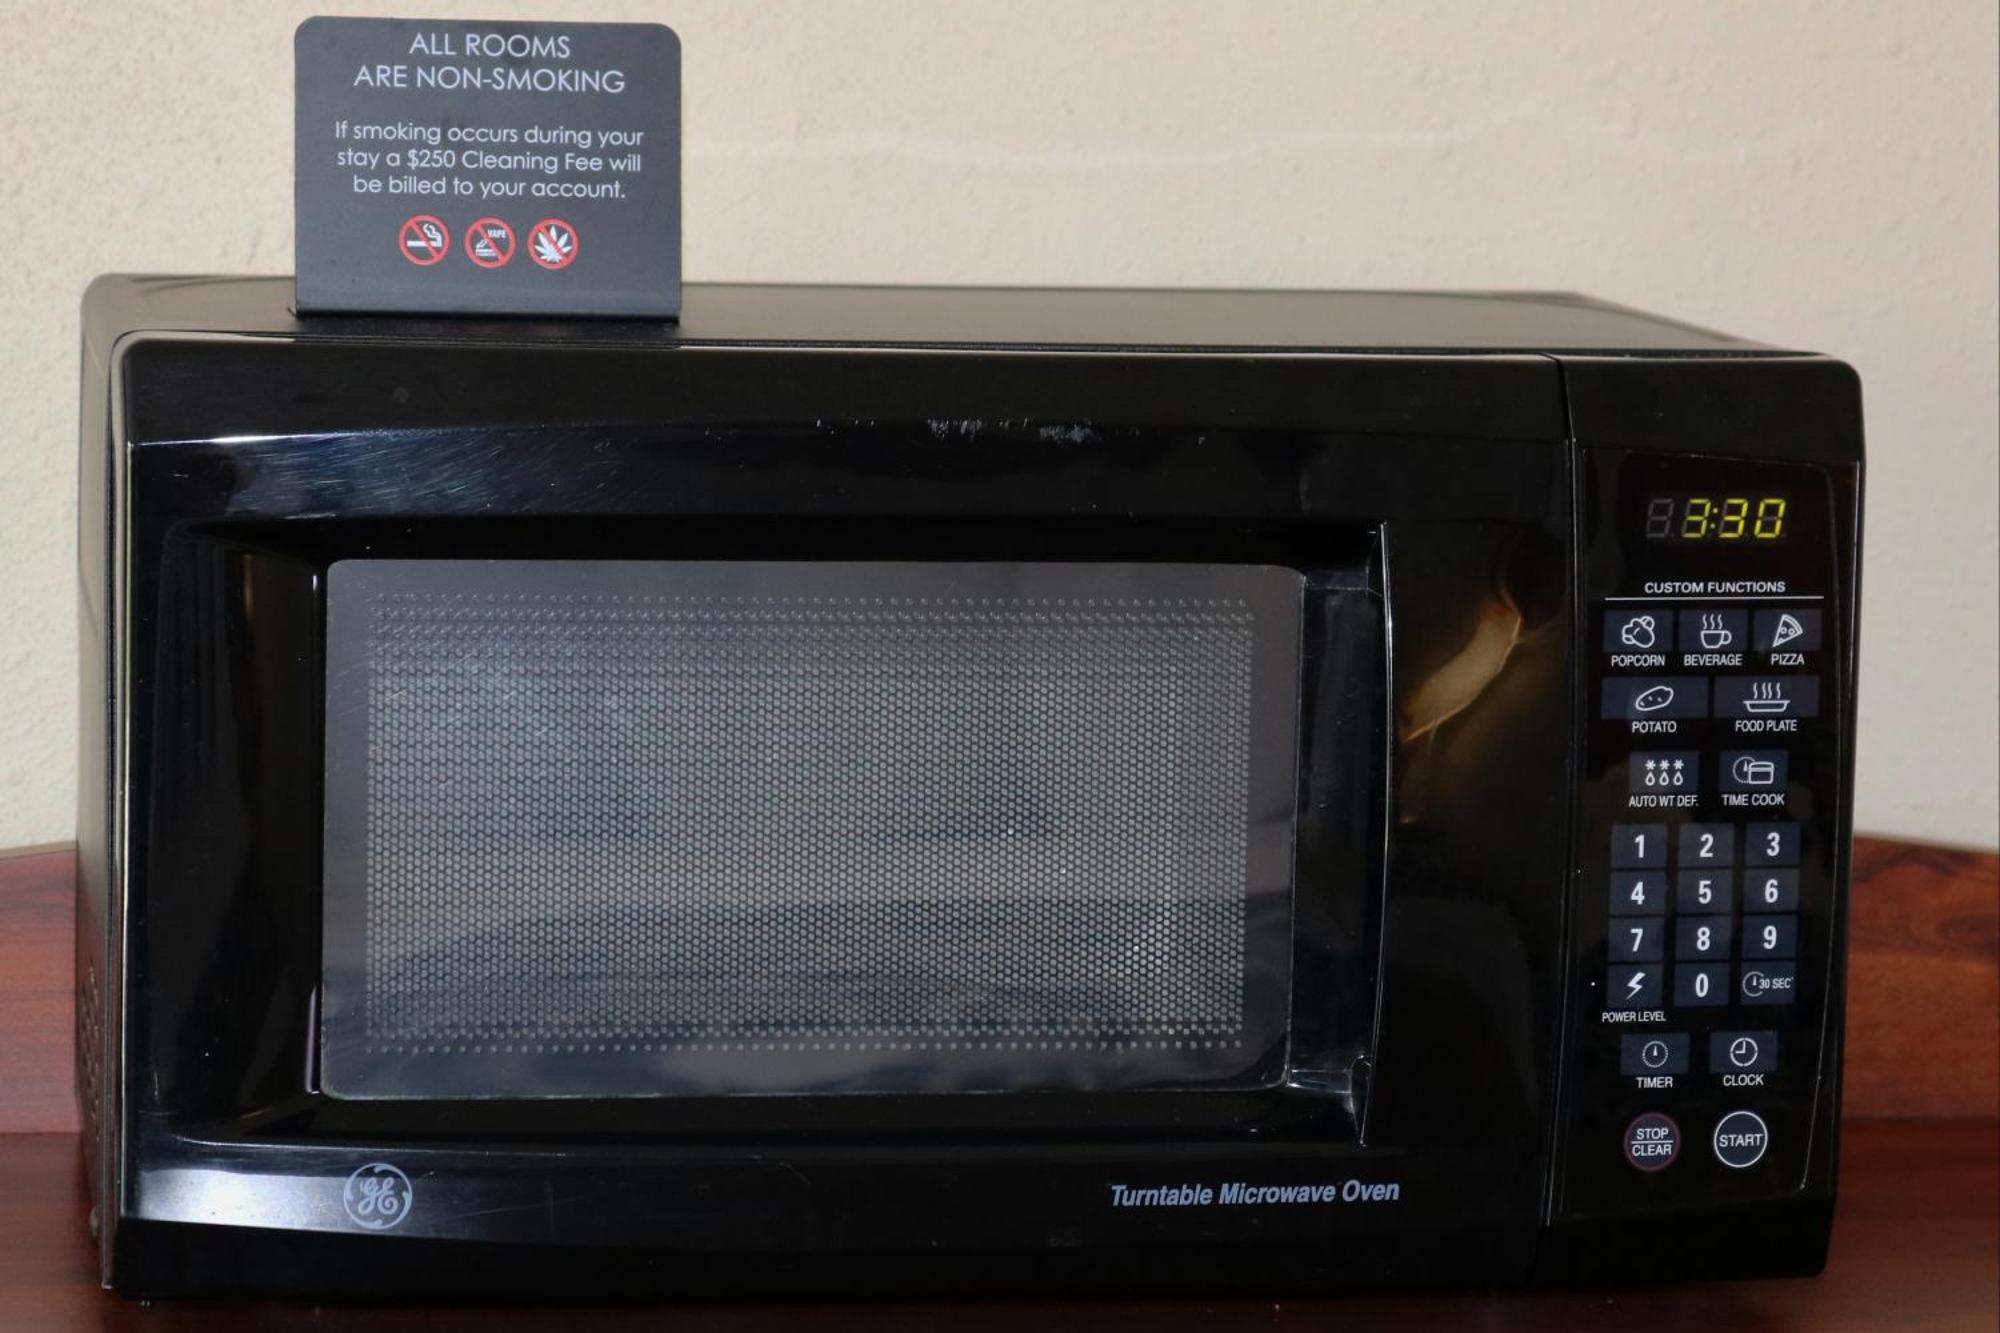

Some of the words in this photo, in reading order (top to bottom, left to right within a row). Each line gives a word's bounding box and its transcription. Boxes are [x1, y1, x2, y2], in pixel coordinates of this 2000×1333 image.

[409, 32, 456, 56] ALL
[466, 34, 571, 58] ROOMS
[353, 65, 407, 87] ARE
[416, 67, 626, 93] NON-SMOKING
[335, 121, 349, 140] If
[352, 122, 441, 145] smoking
[447, 125, 518, 143] occurs
[524, 125, 592, 148] during
[598, 129, 644, 147] your
[337, 150, 380, 171] stay
[386, 152, 401, 167] a
[406, 148, 456, 169] $250
[461, 150, 558, 174] Cleaning
[564, 153, 603, 171] Fee
[608, 154, 641, 172] will
[353, 175, 383, 193] be
[388, 175, 446, 195] billed
[453, 178, 473, 195] to
[480, 180, 526, 199] your
[531, 180, 626, 199] account.
[487, 229, 507, 239] VAPE
[1682, 498, 1786, 538] 3:30
[1644, 582, 1704, 594] CUSTOM
[1707, 581, 1786, 593] FUNCTIONS
[1611, 655, 1666, 667] POPCORN
[1683, 654, 1743, 666] BEVERAGE
[1771, 653, 1805, 665] PIZZA
[1631, 721, 1677, 733] POTATO
[1735, 720, 1765, 732] FOOD
[1766, 720, 1798, 732] PLATE
[1628, 795, 1657, 808] AUTO
[1658, 795, 1678, 807] WT
[1677, 795, 1699, 807] DEF.
[1721, 794, 1750, 806] TIME
[1751, 793, 1785, 806] COOK
[1634, 835, 1645, 859] 1
[1699, 833, 1714, 858] 2
[1766, 832, 1780, 857] 3
[1631, 881, 1645, 905] 4
[1698, 880, 1712, 904] 5
[1764, 879, 1779, 903] 6
[1630, 928, 1644, 952] 7
[1696, 926, 1711, 951] 8
[1763, 925, 1777, 950] 9
[1695, 973, 1709, 997] 0
[1759, 978, 1771, 990] 30
[1601, 1011, 1636, 1023] POWER
[1638, 1011, 1667, 1022] LEVEL
[1636, 1077, 1673, 1089] TIMER
[1723, 1074, 1764, 1087] CLOCK
[1636, 1128, 1669, 1140] STOP
[1719, 1134, 1764, 1147] START
[1631, 1144, 1672, 1157] CLEAR
[1111, 1184, 1213, 1207] Turntable
[1218, 1182, 1336, 1205] Microwave
[1342, 1180, 1400, 1202] Oven
